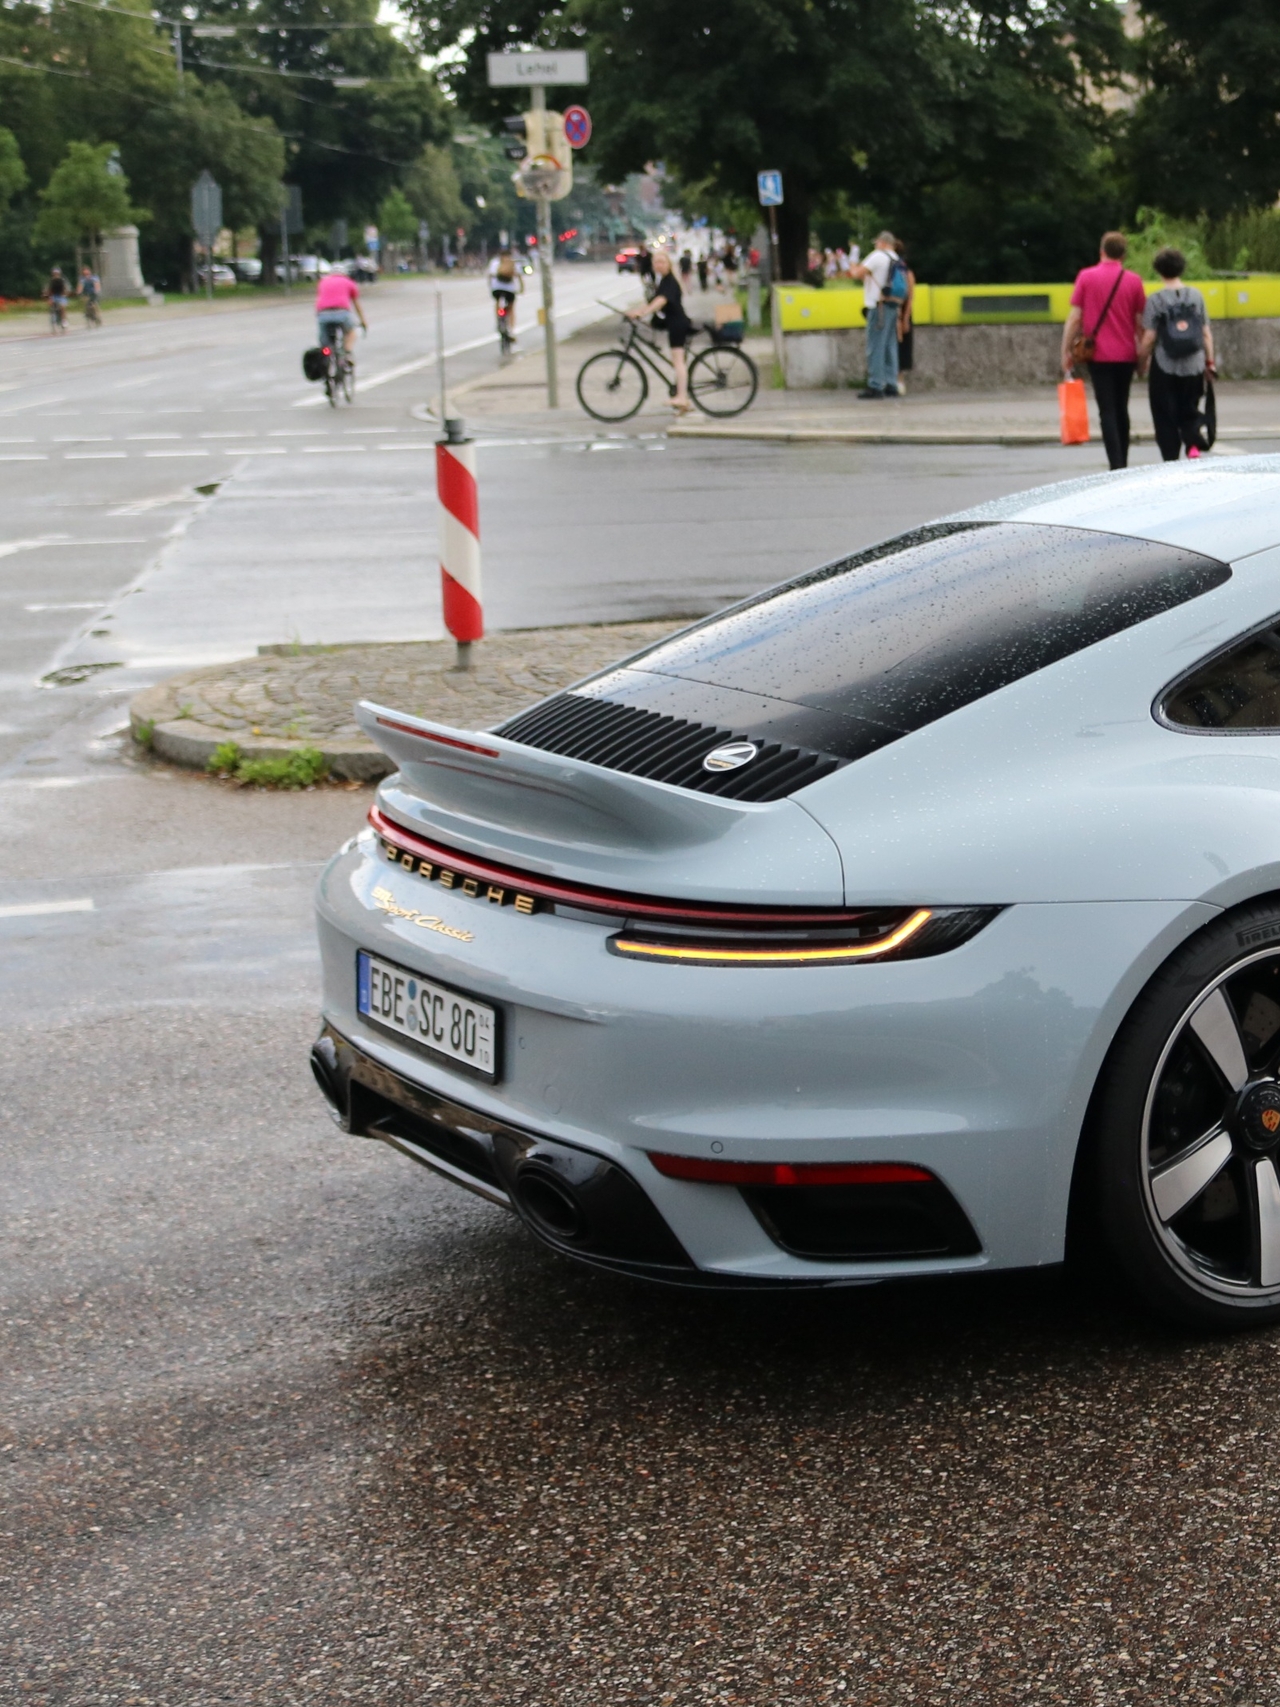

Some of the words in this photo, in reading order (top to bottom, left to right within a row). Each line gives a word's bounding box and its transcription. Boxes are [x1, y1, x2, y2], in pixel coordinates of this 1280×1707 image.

[386, 846, 535, 916] PORSCHE
[374, 898, 421, 923] Sport
[413, 914, 476, 943] Classic
[371, 966, 405, 1026] EBE
[419, 988, 444, 1043] SC
[450, 1002, 477, 1057] 80
